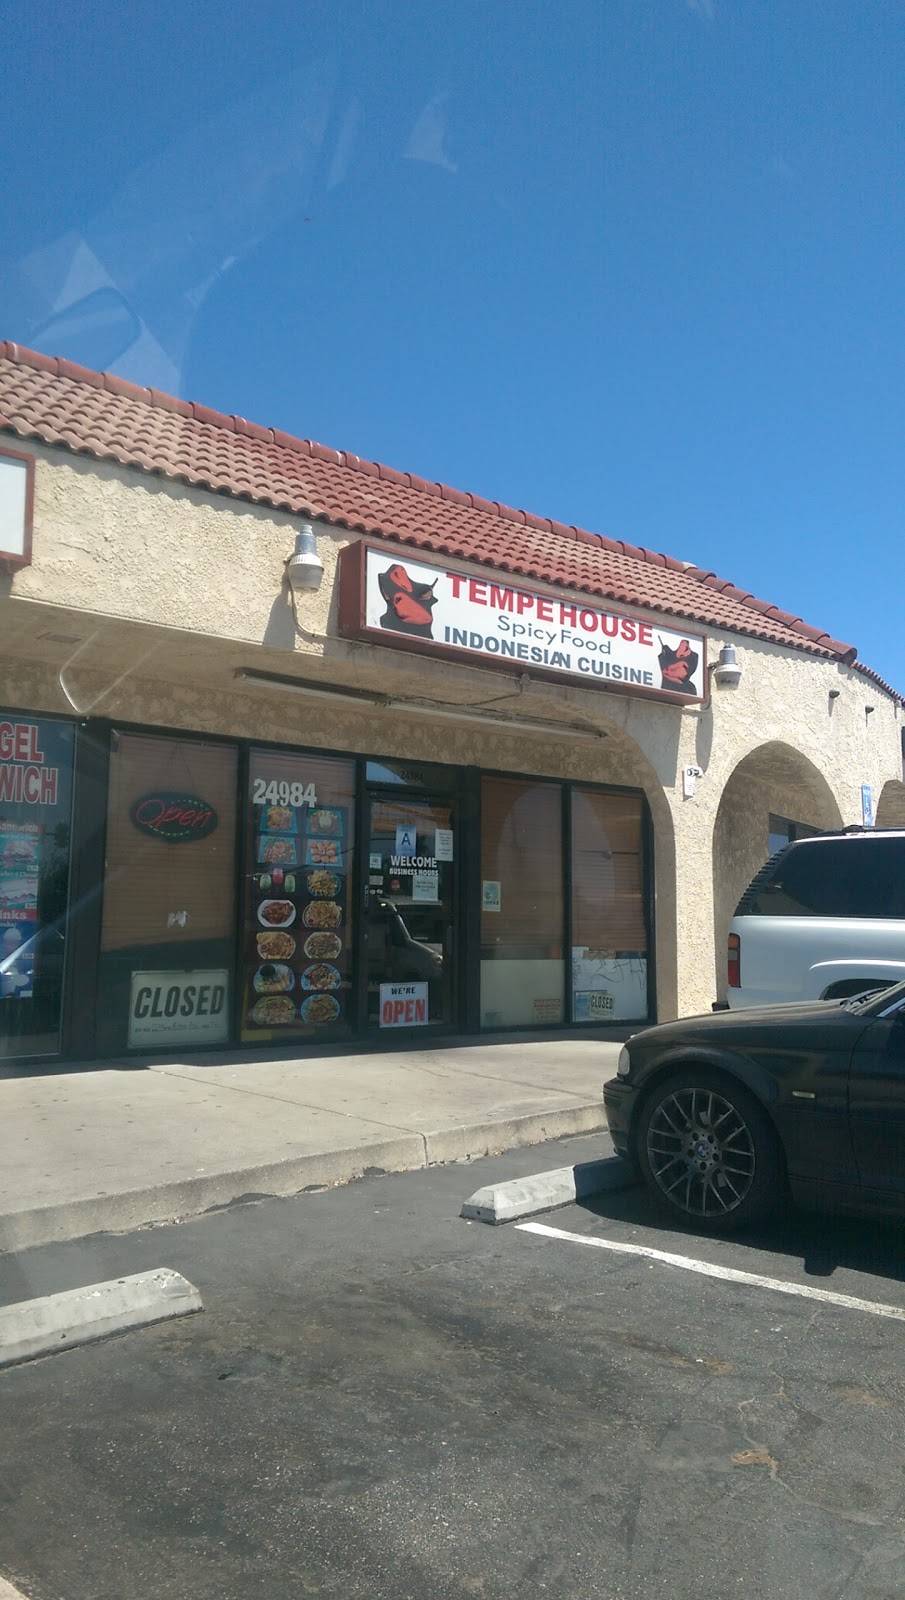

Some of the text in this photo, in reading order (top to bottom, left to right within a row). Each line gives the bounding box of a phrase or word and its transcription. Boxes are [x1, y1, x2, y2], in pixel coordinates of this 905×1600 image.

[497, 615, 612, 655] Spicy Food
[444, 626, 653, 686] INDONESIAN CUISINE
[253, 778, 317, 808] 24984
[136, 799, 214, 828] Open
[401, 833, 411, 846] A
[389, 868, 439, 877] BUSINESS HOURS
[390, 855, 438, 868] WELCOME
[134, 985, 225, 1019] CLOSED
[391, 987, 416, 995] WE'RE
[591, 995, 614, 1010] CLOSED
[383, 999, 426, 1024] OPEN
